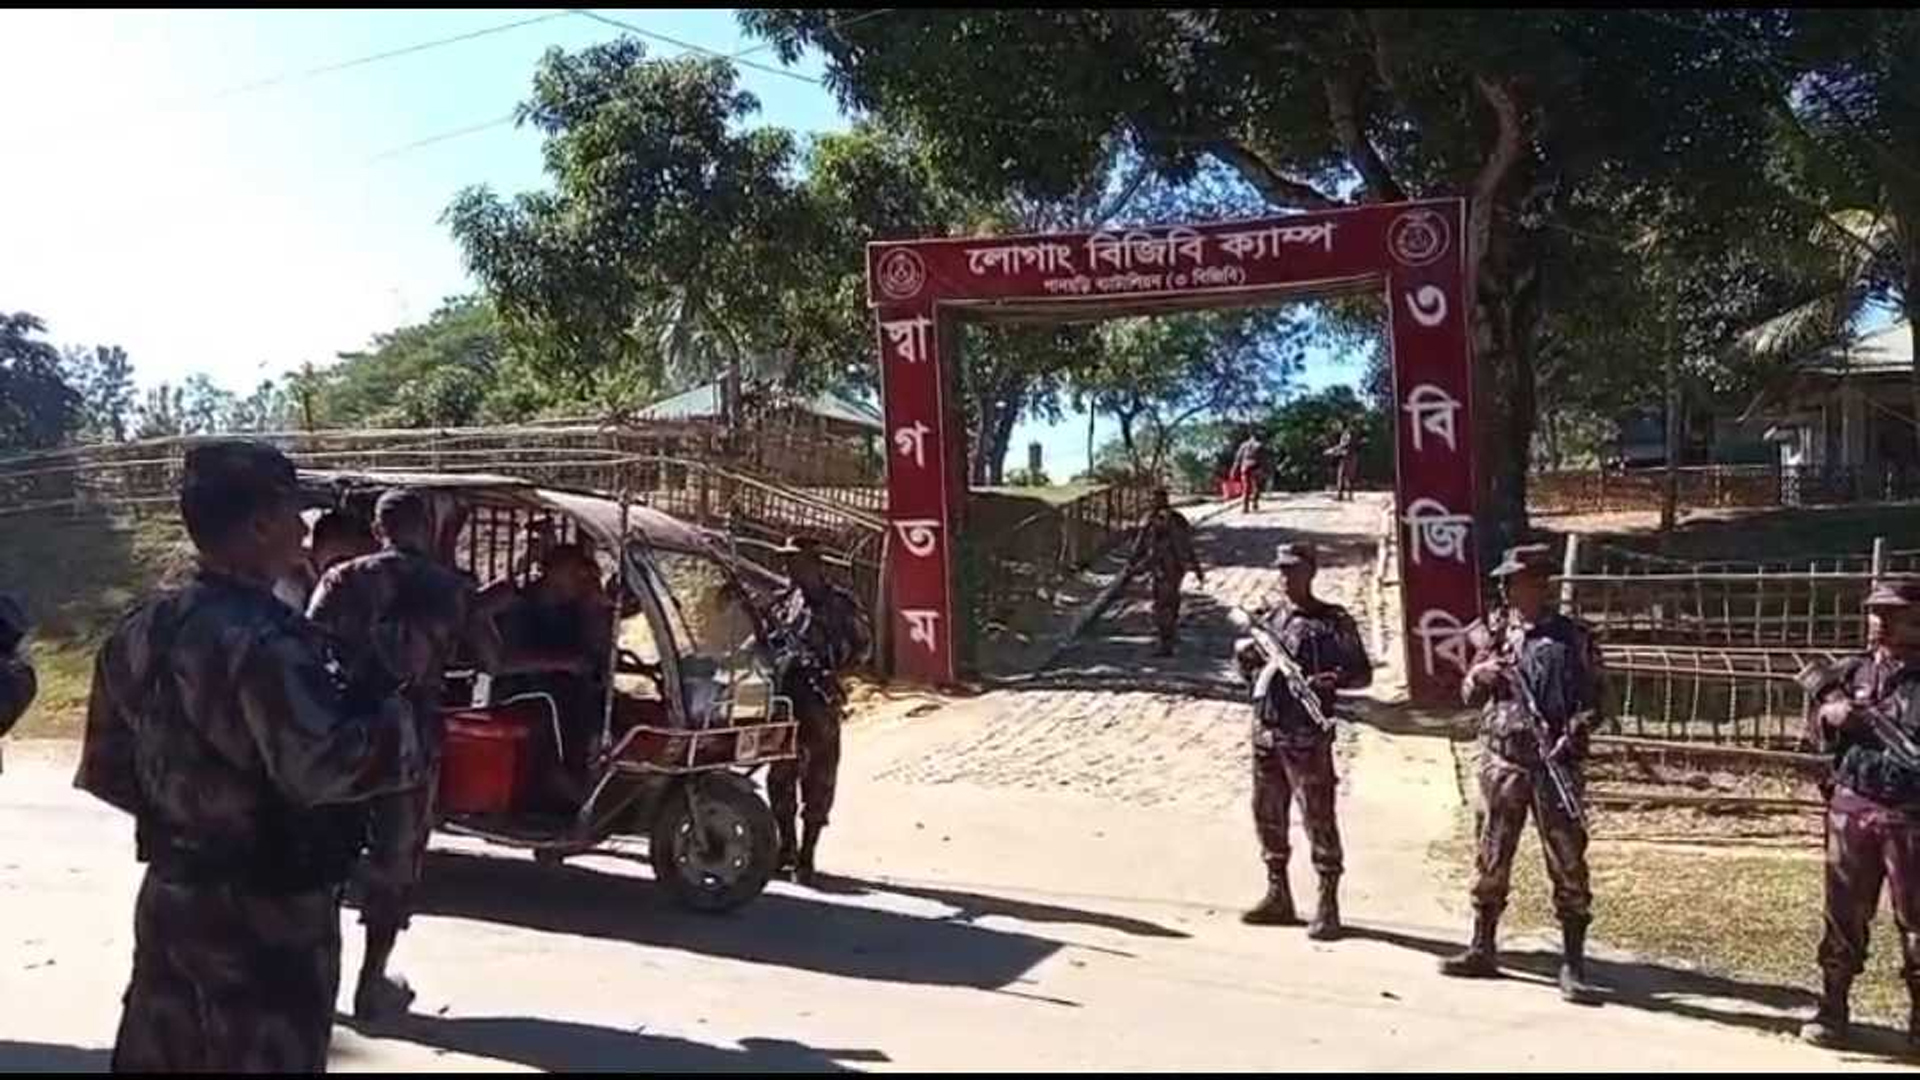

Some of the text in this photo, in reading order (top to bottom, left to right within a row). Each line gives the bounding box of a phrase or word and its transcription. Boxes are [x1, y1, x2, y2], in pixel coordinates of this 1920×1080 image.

[964, 221, 1337, 276] লোগাং বিজিবি ক্যাম্প
